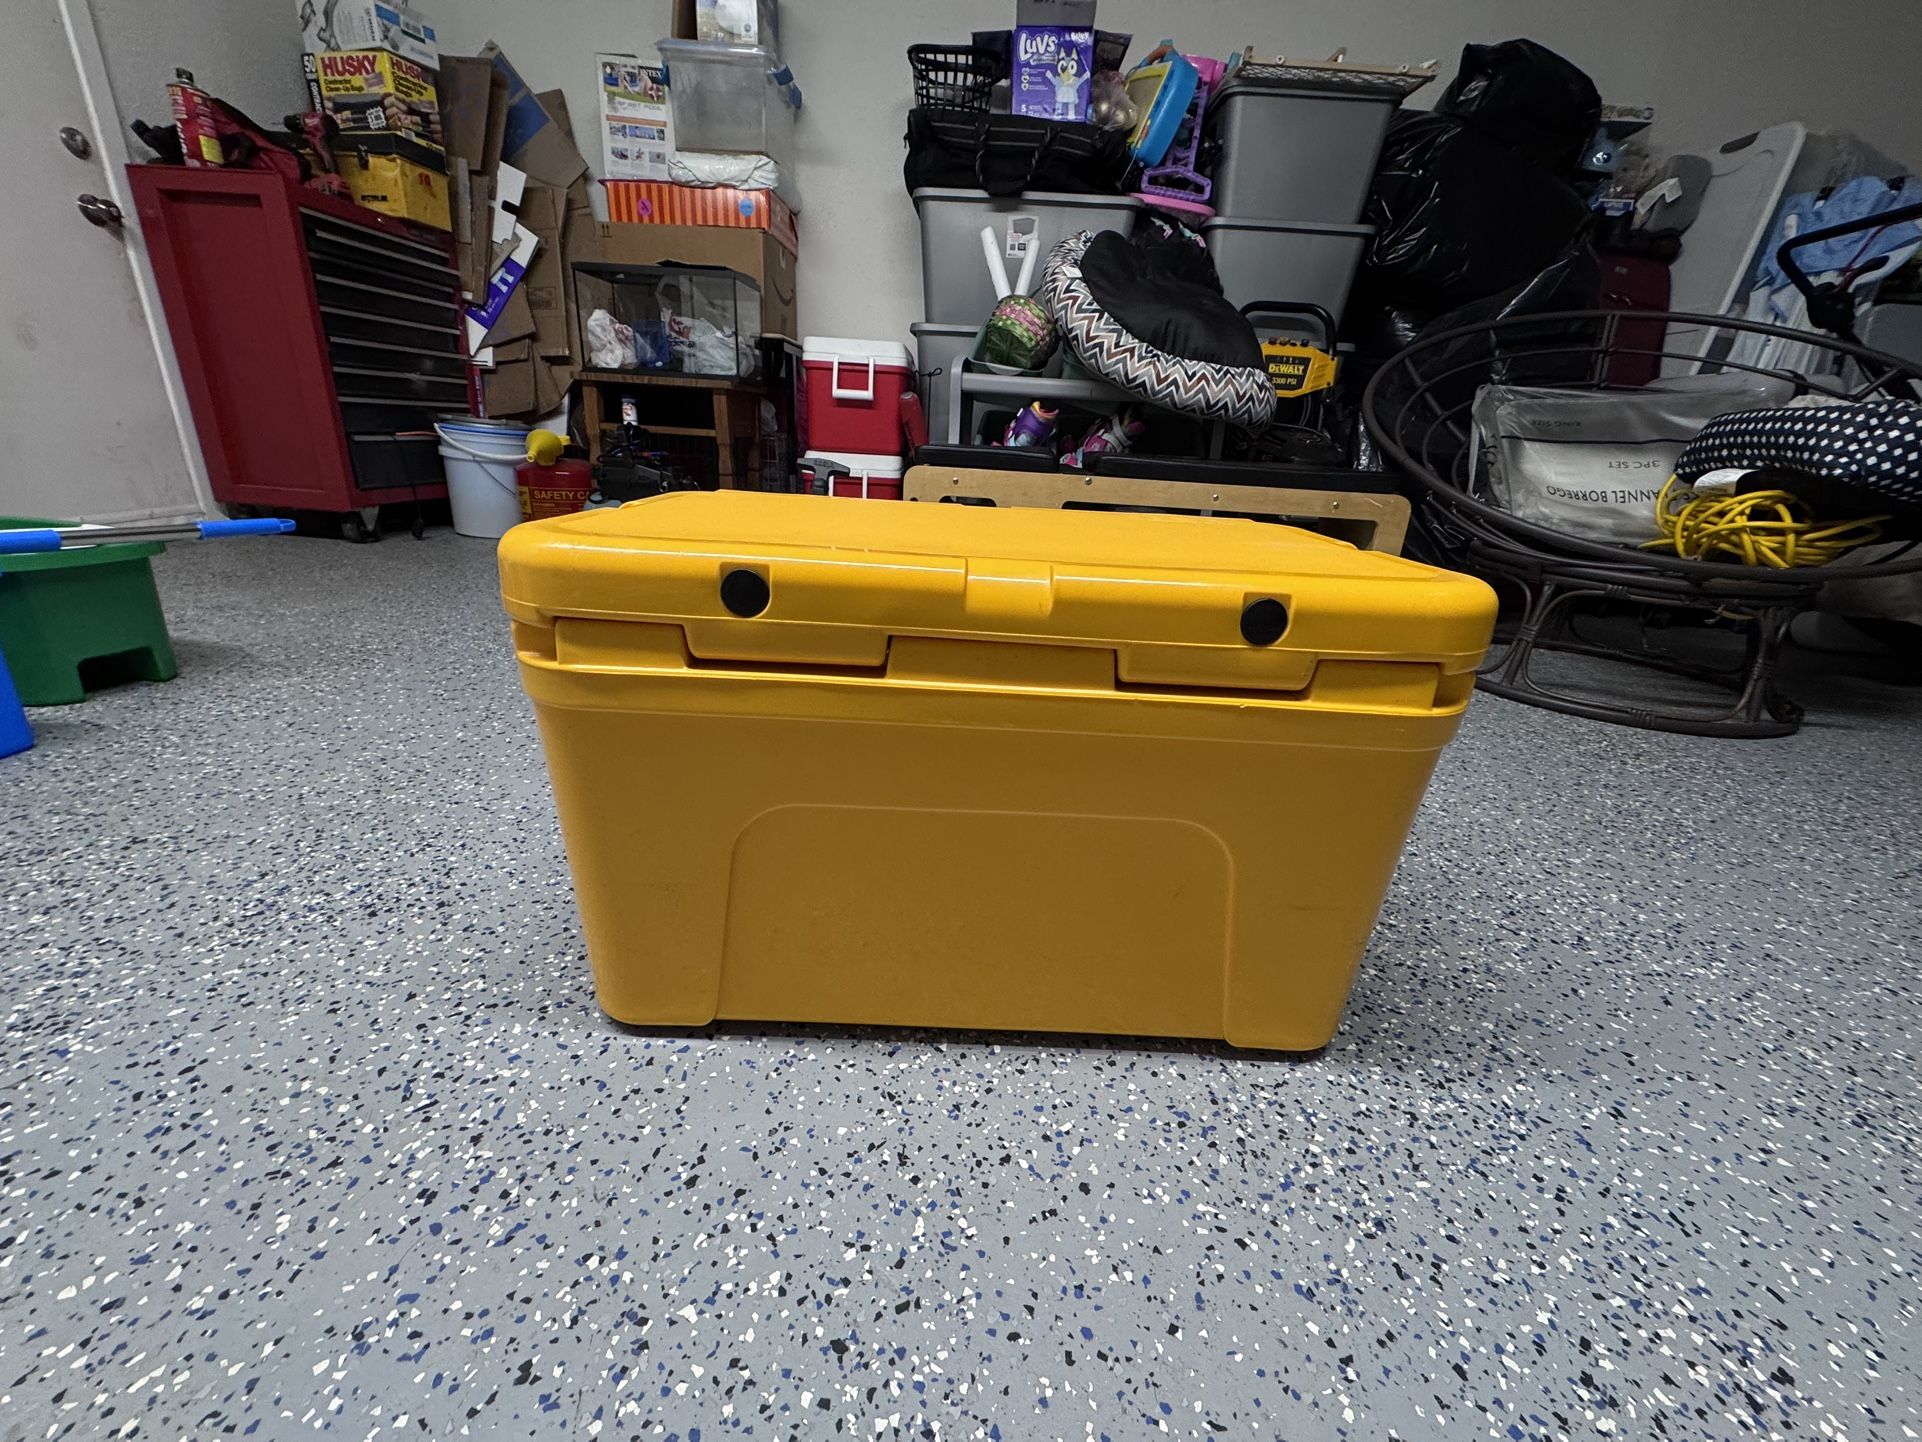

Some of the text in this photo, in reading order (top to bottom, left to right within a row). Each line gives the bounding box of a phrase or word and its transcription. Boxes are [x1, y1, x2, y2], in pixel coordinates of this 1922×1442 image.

[303, 55, 316, 73] 50
[320, 54, 377, 77] HUSKY
[1287, 377, 1297, 385] PSI
[1608, 460, 1661, 469] 3PC SET
[534, 490, 574, 500] SAFETY
[1546, 485, 1608, 503] BORREGO
